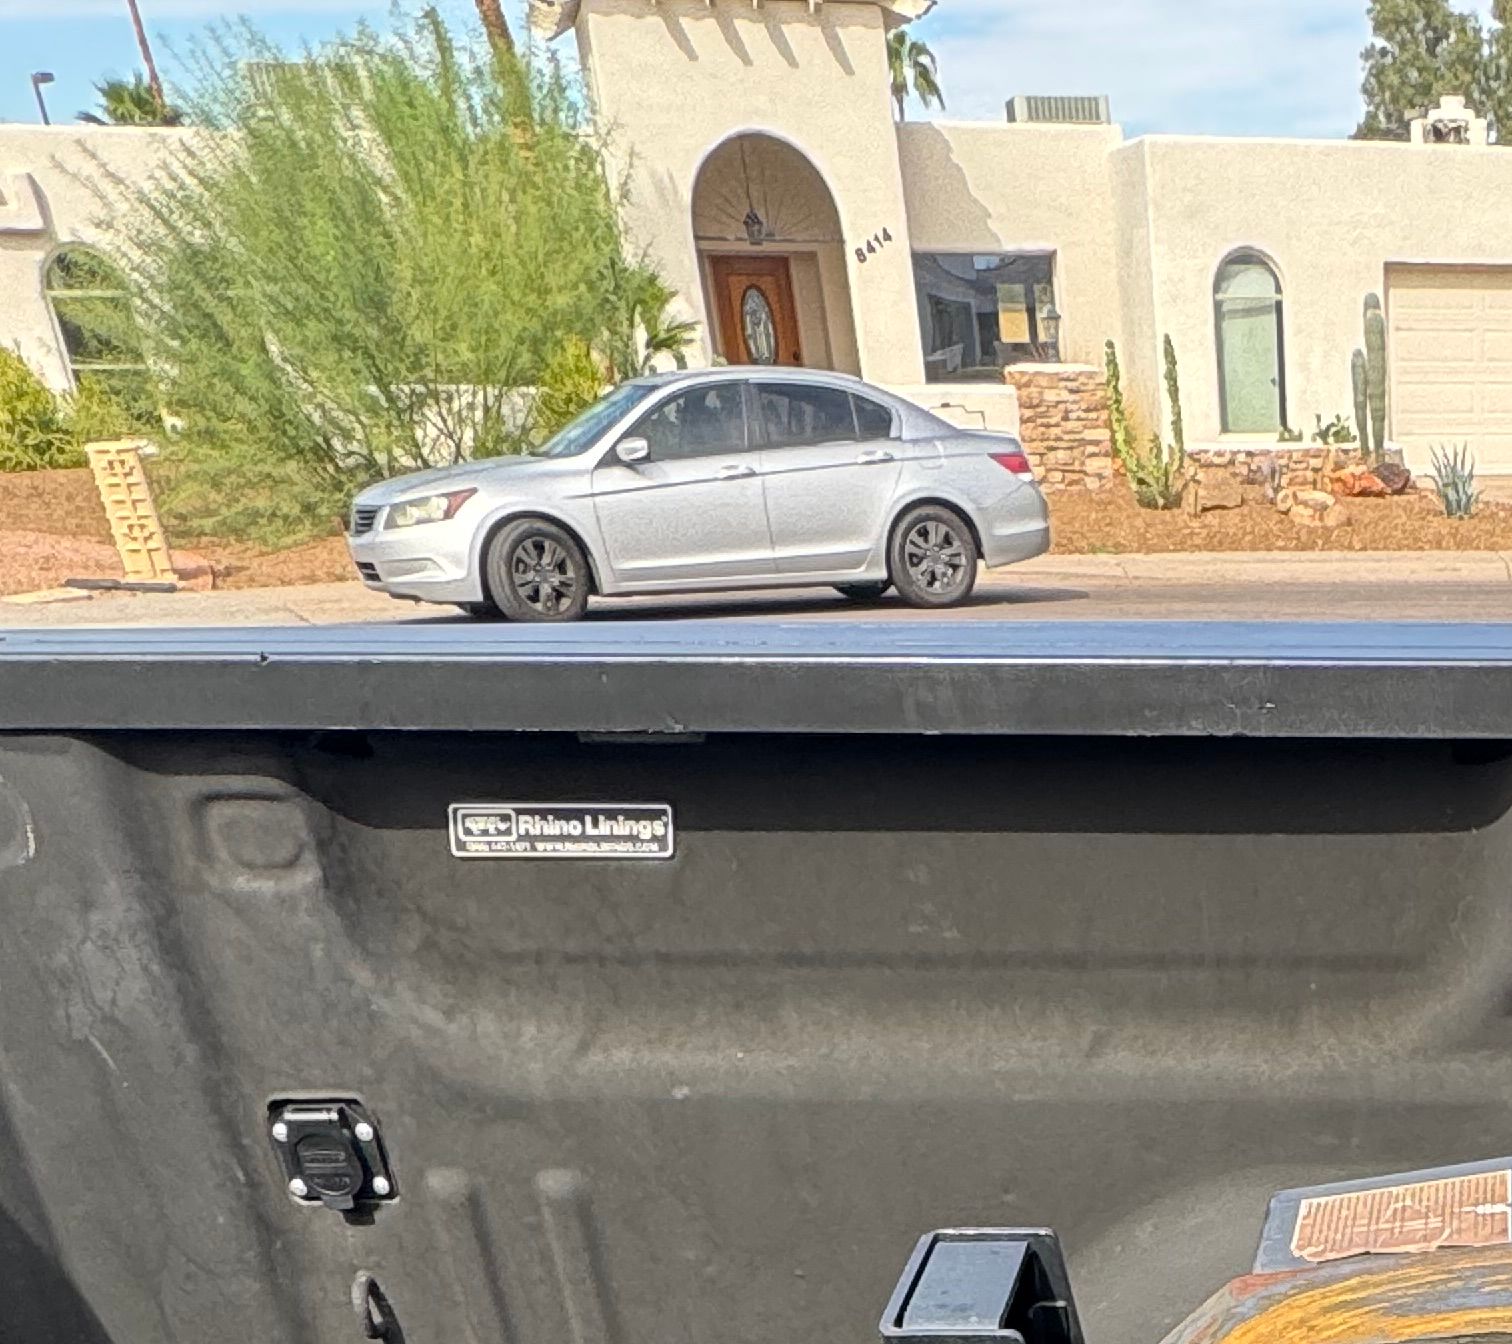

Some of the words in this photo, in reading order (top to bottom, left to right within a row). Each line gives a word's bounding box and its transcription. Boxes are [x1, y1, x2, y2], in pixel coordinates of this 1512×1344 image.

[855, 227, 892, 263] 8414
[518, 814, 582, 836] Rhino
[584, 814, 666, 840] Linings
